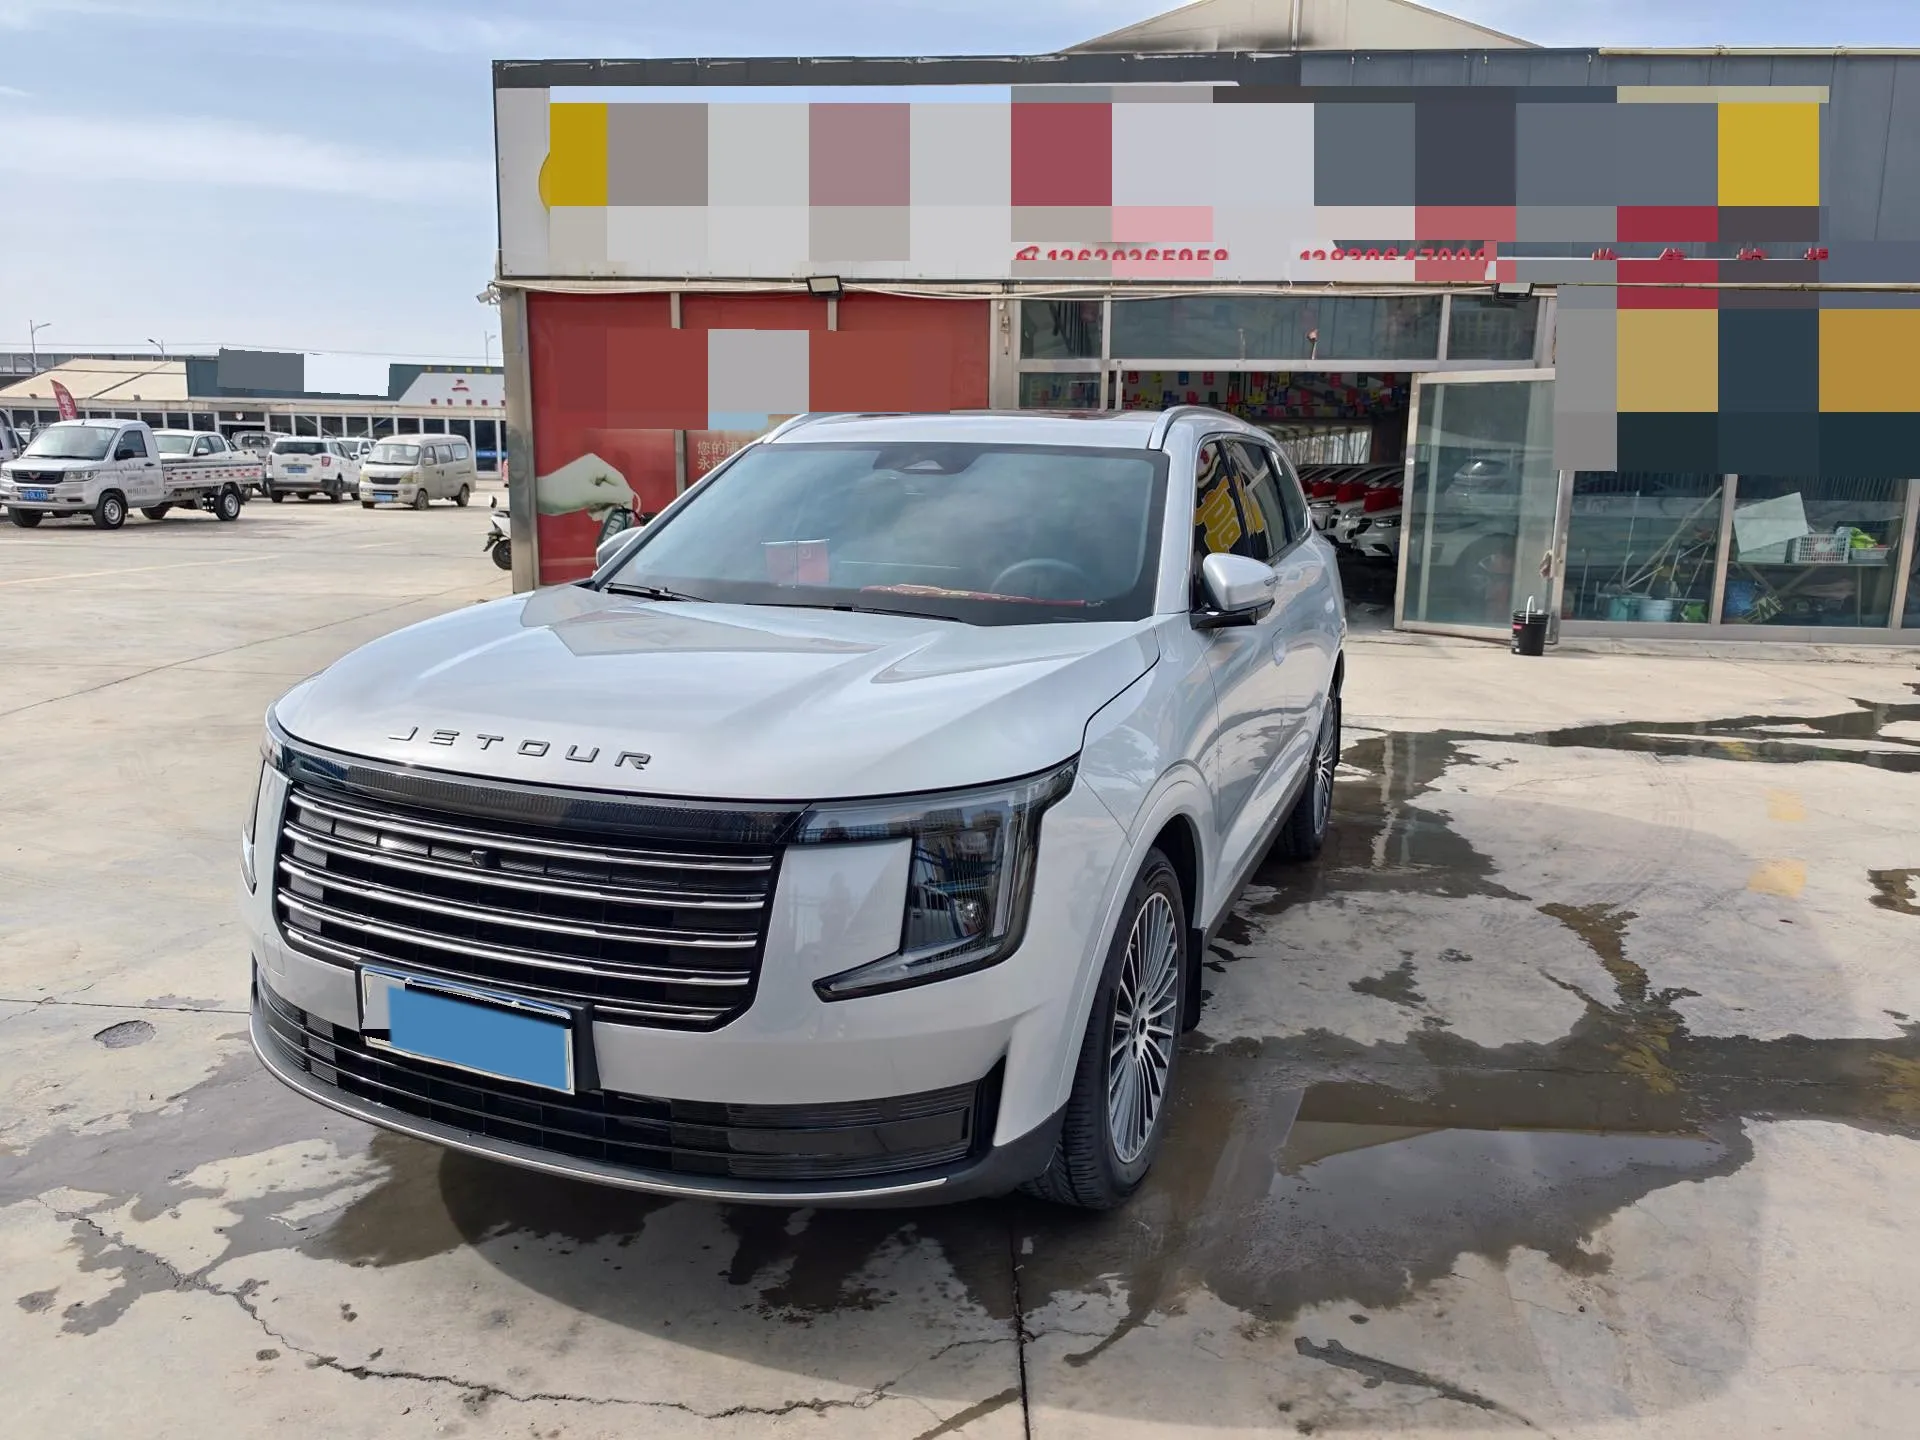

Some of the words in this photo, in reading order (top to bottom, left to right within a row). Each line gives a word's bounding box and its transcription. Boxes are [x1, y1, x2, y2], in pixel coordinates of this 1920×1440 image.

[697, 440, 749, 456] 您的满
[388, 726, 652, 770] JETOUR
